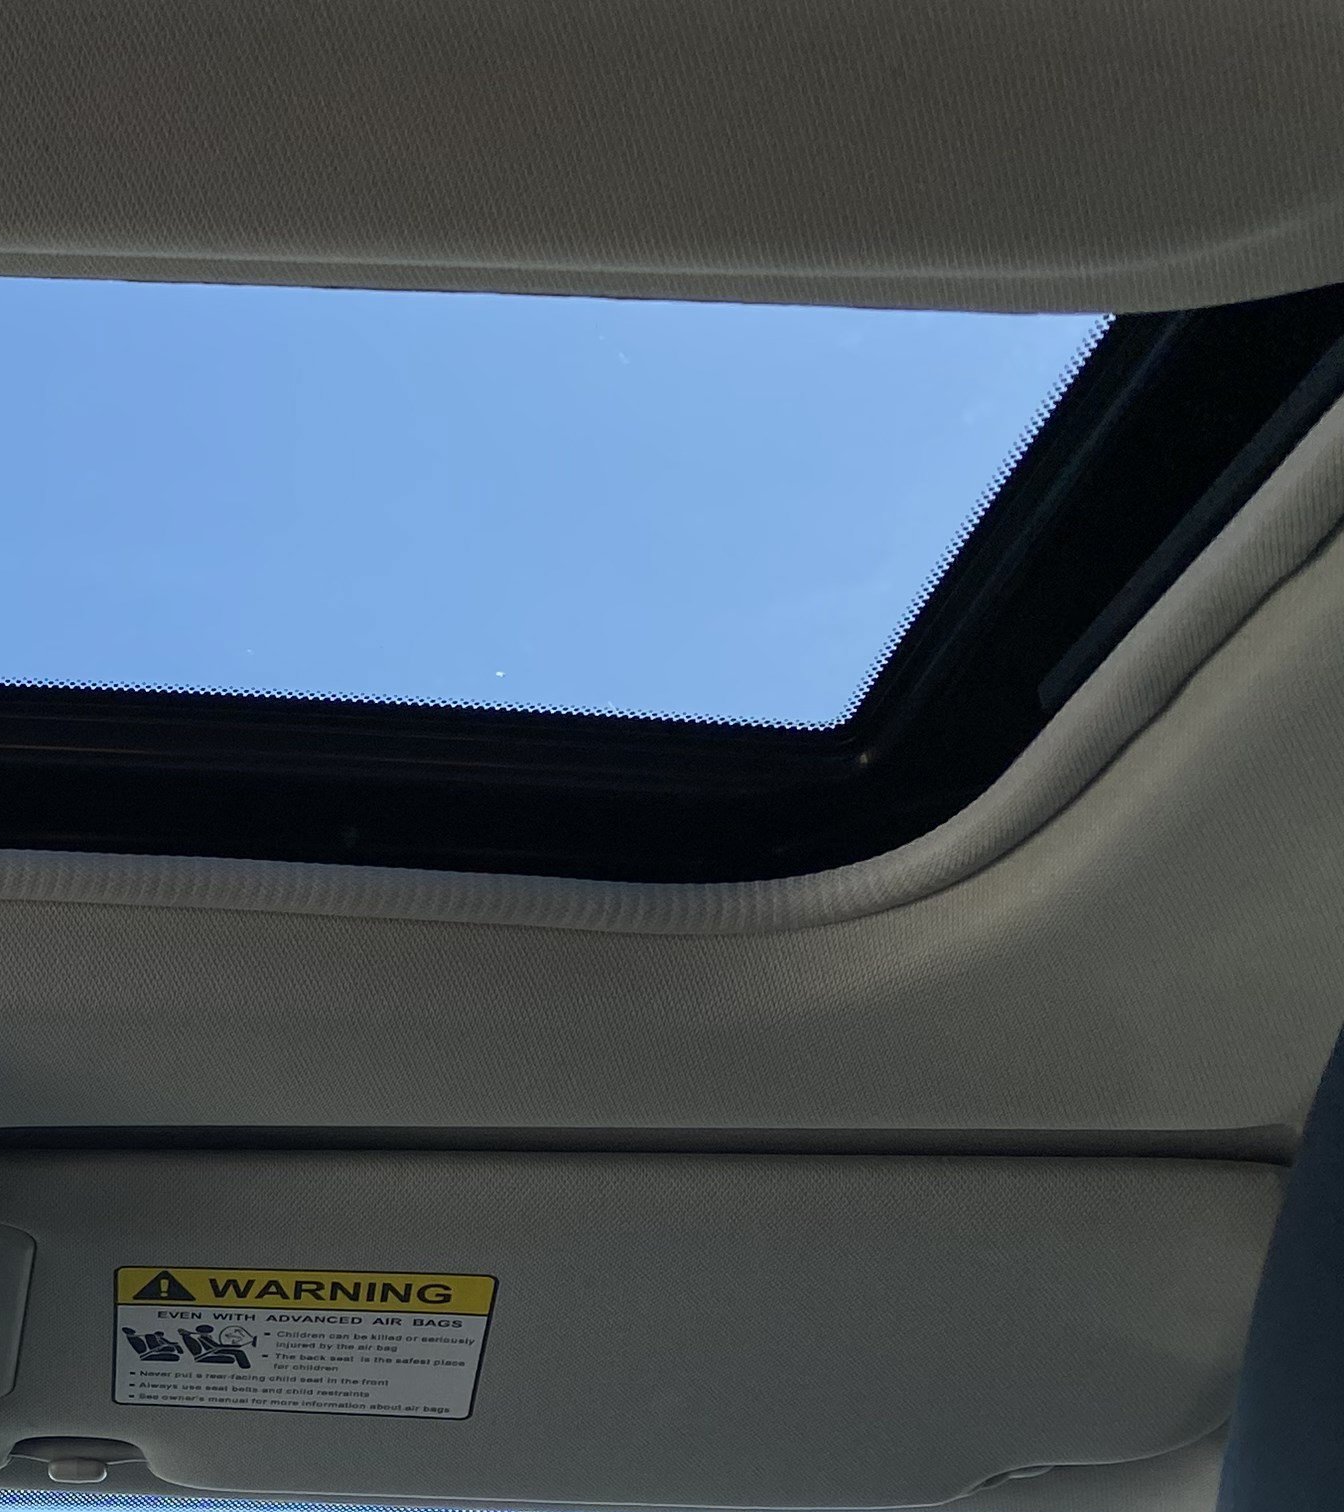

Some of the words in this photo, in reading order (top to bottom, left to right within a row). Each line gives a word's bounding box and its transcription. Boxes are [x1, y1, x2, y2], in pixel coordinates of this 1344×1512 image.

[208, 1278, 453, 1304] WARNING
[157, 1311, 202, 1319] EVEN
[212, 1313, 255, 1321] WITH
[266, 1314, 362, 1325] ADVANCED
[372, 1317, 402, 1326] AIR
[413, 1318, 463, 1328] BAGS
[277, 1330, 325, 1339] Children
[371, 1333, 402, 1341] killed
[421, 1335, 475, 1345] seriously
[276, 1341, 315, 1350] injured
[319, 1342, 332, 1351] by
[336, 1342, 354, 1350] the
[377, 1344, 397, 1352] bag
[275, 1353, 296, 1361] The
[299, 1353, 326, 1361] back
[395, 1357, 430, 1365] safest
[433, 1359, 465, 1367] place
[292, 1363, 339, 1372] children
